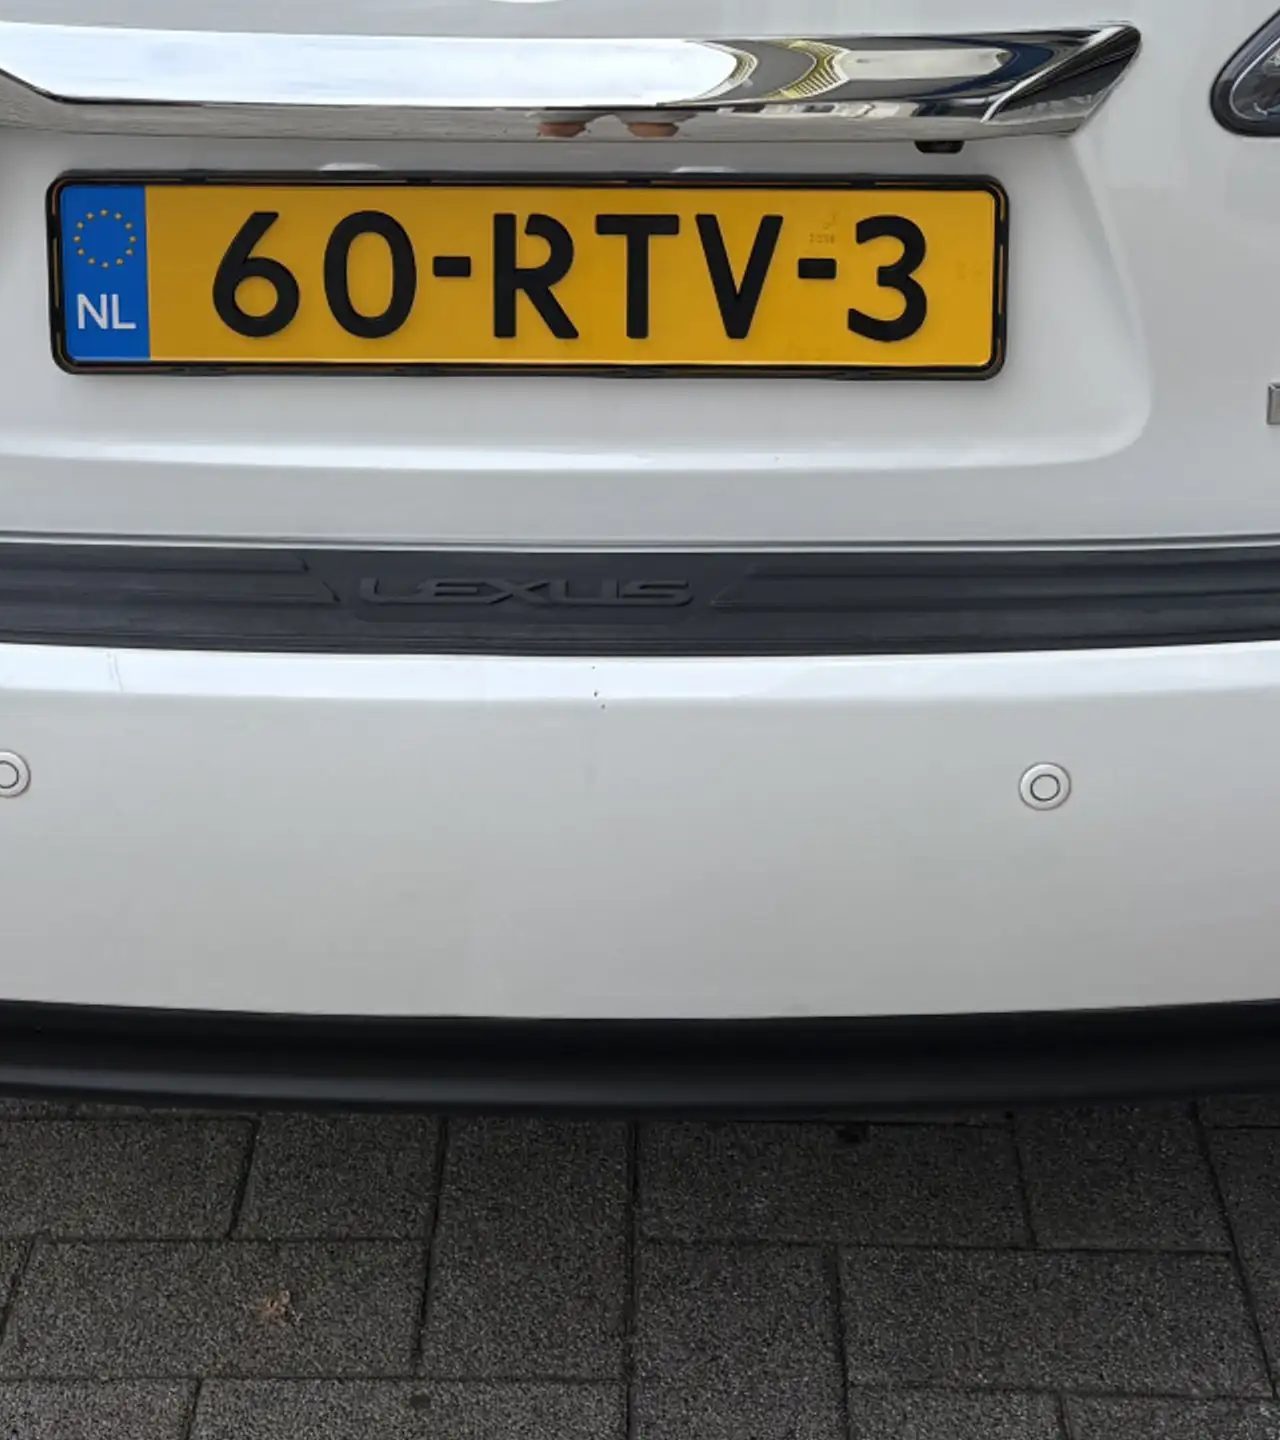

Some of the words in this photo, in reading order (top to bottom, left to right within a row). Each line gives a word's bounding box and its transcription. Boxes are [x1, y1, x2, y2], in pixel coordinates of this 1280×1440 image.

[212, 210, 928, 342] 60-RTV-3
[77, 293, 136, 330] NL
[358, 576, 696, 609] LEXUS
